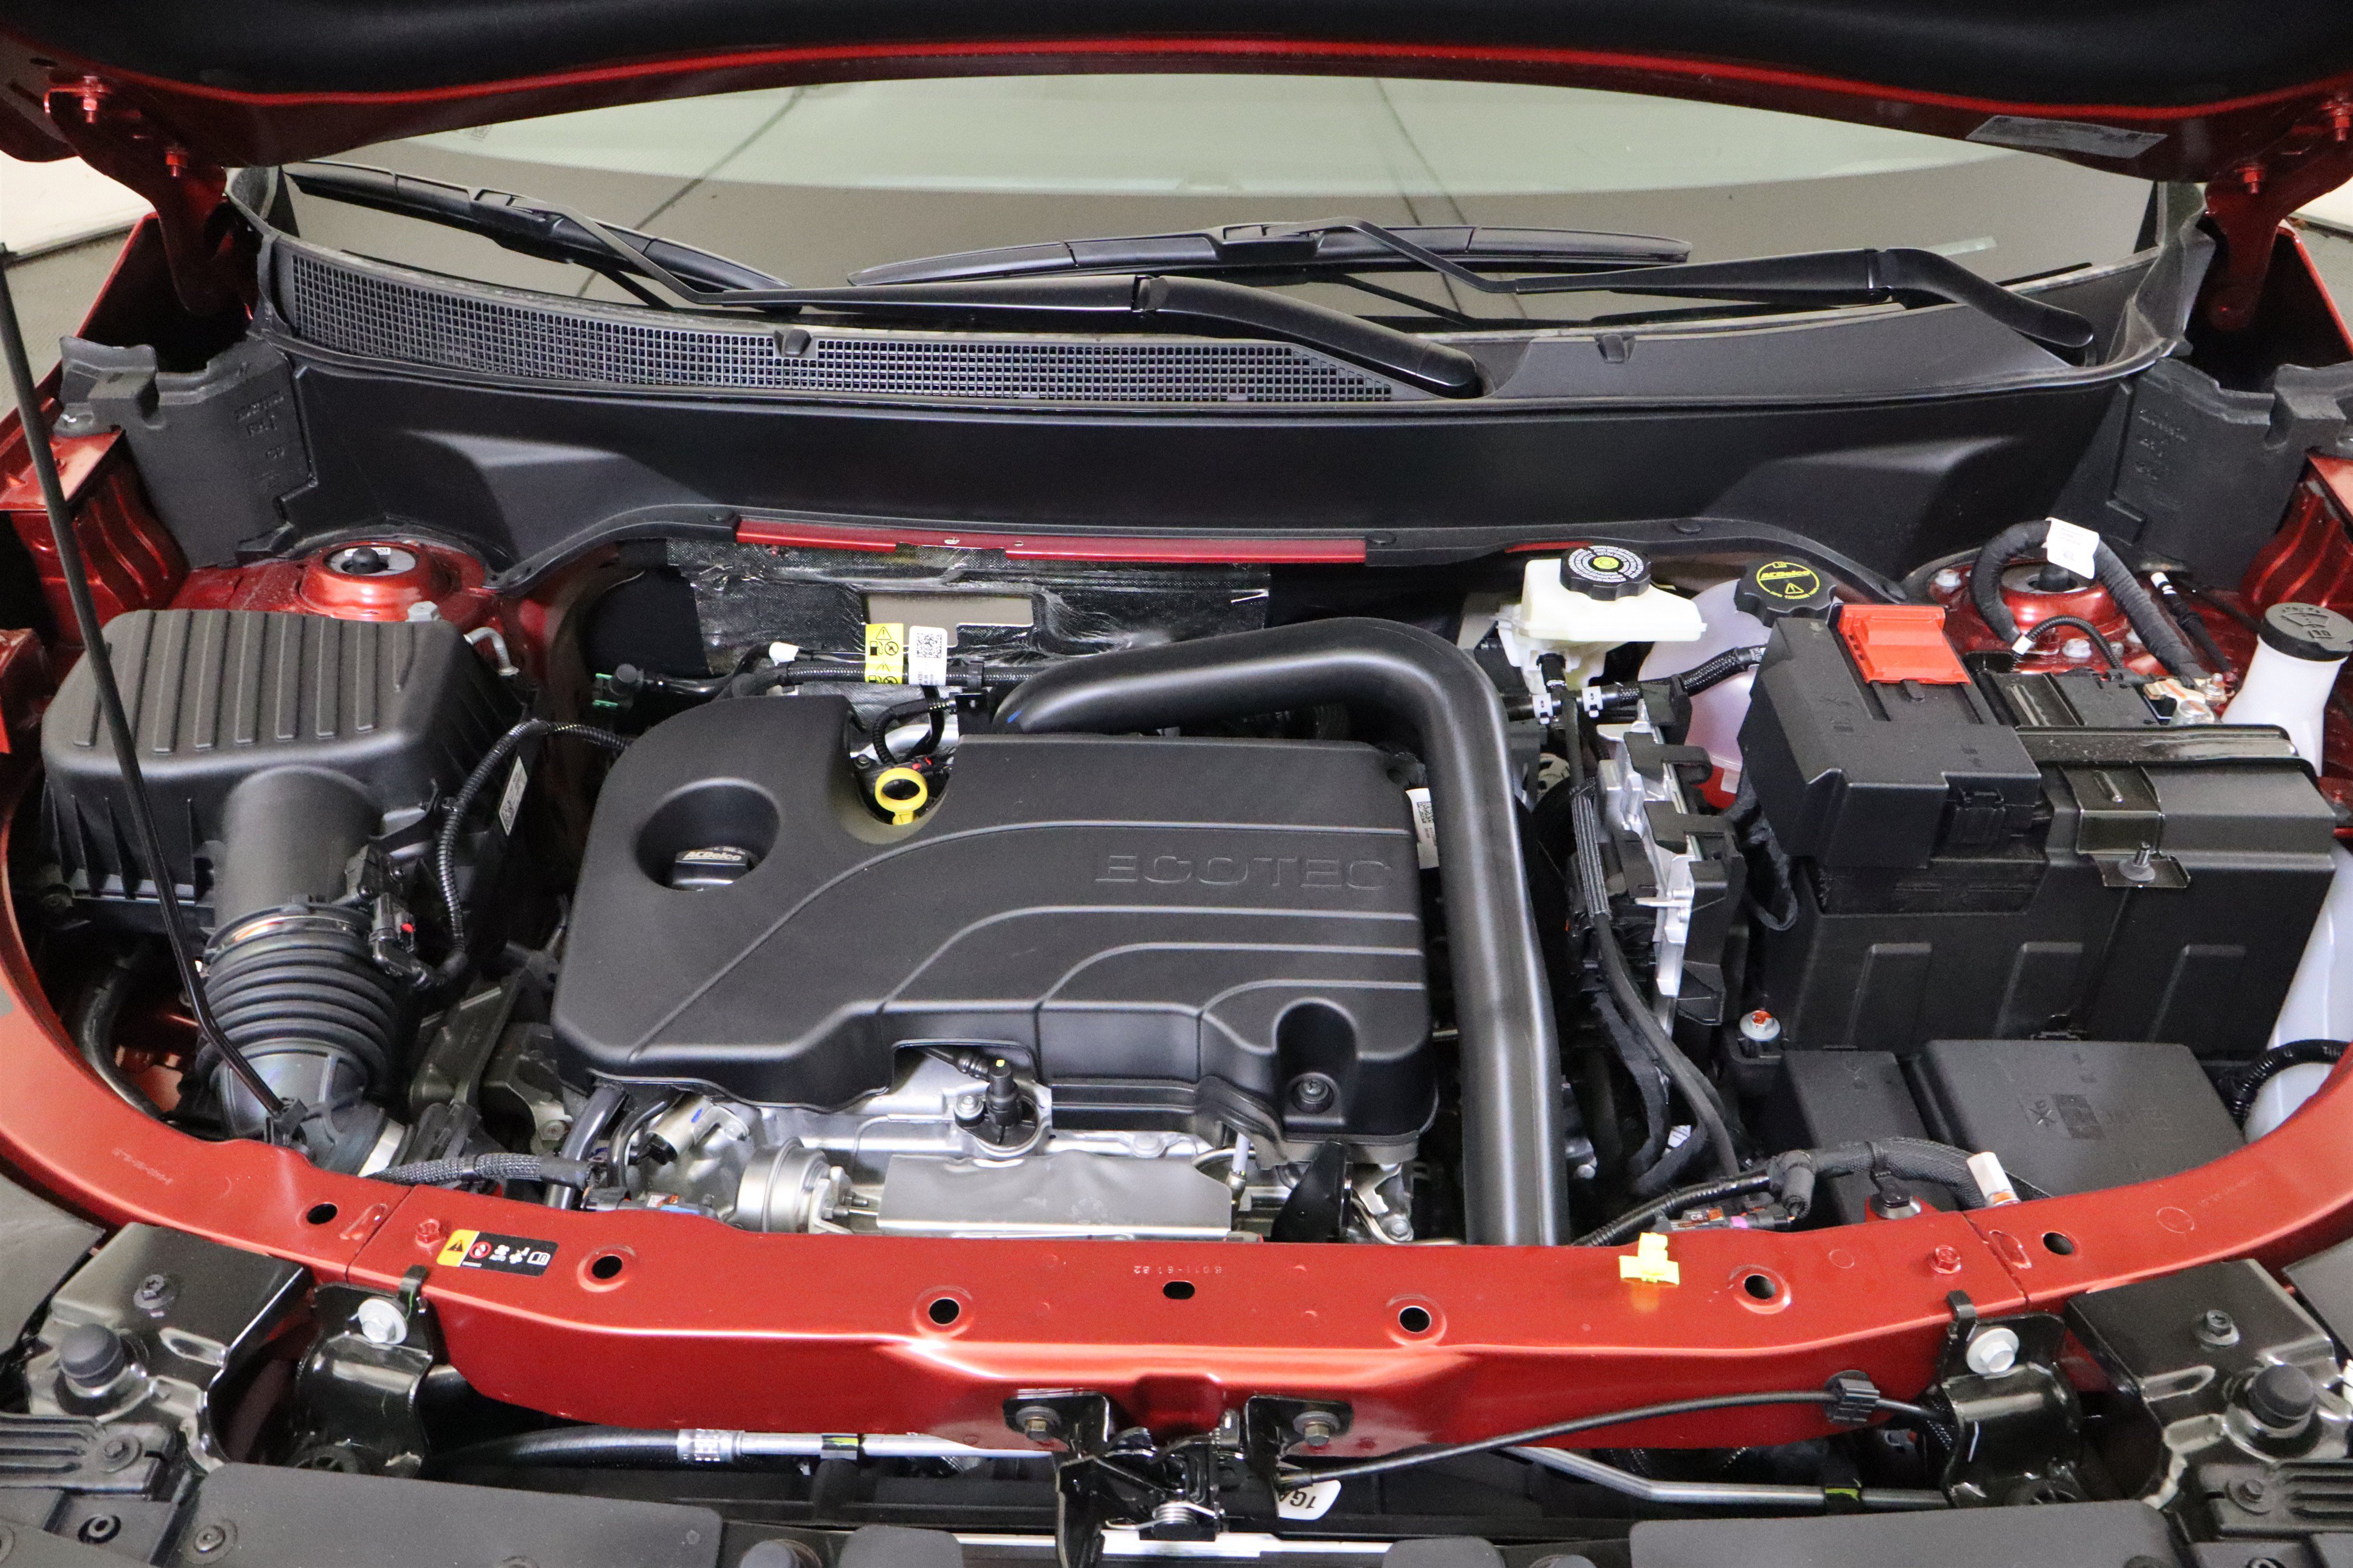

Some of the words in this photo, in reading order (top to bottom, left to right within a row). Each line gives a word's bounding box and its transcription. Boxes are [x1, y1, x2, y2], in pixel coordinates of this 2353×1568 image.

[1761, 570, 1811, 578] ACDelco
[682, 851, 742, 861] ACDelco
[1095, 855, 1392, 890] ECOTEC
[488, 1254, 507, 1262] AUTO
